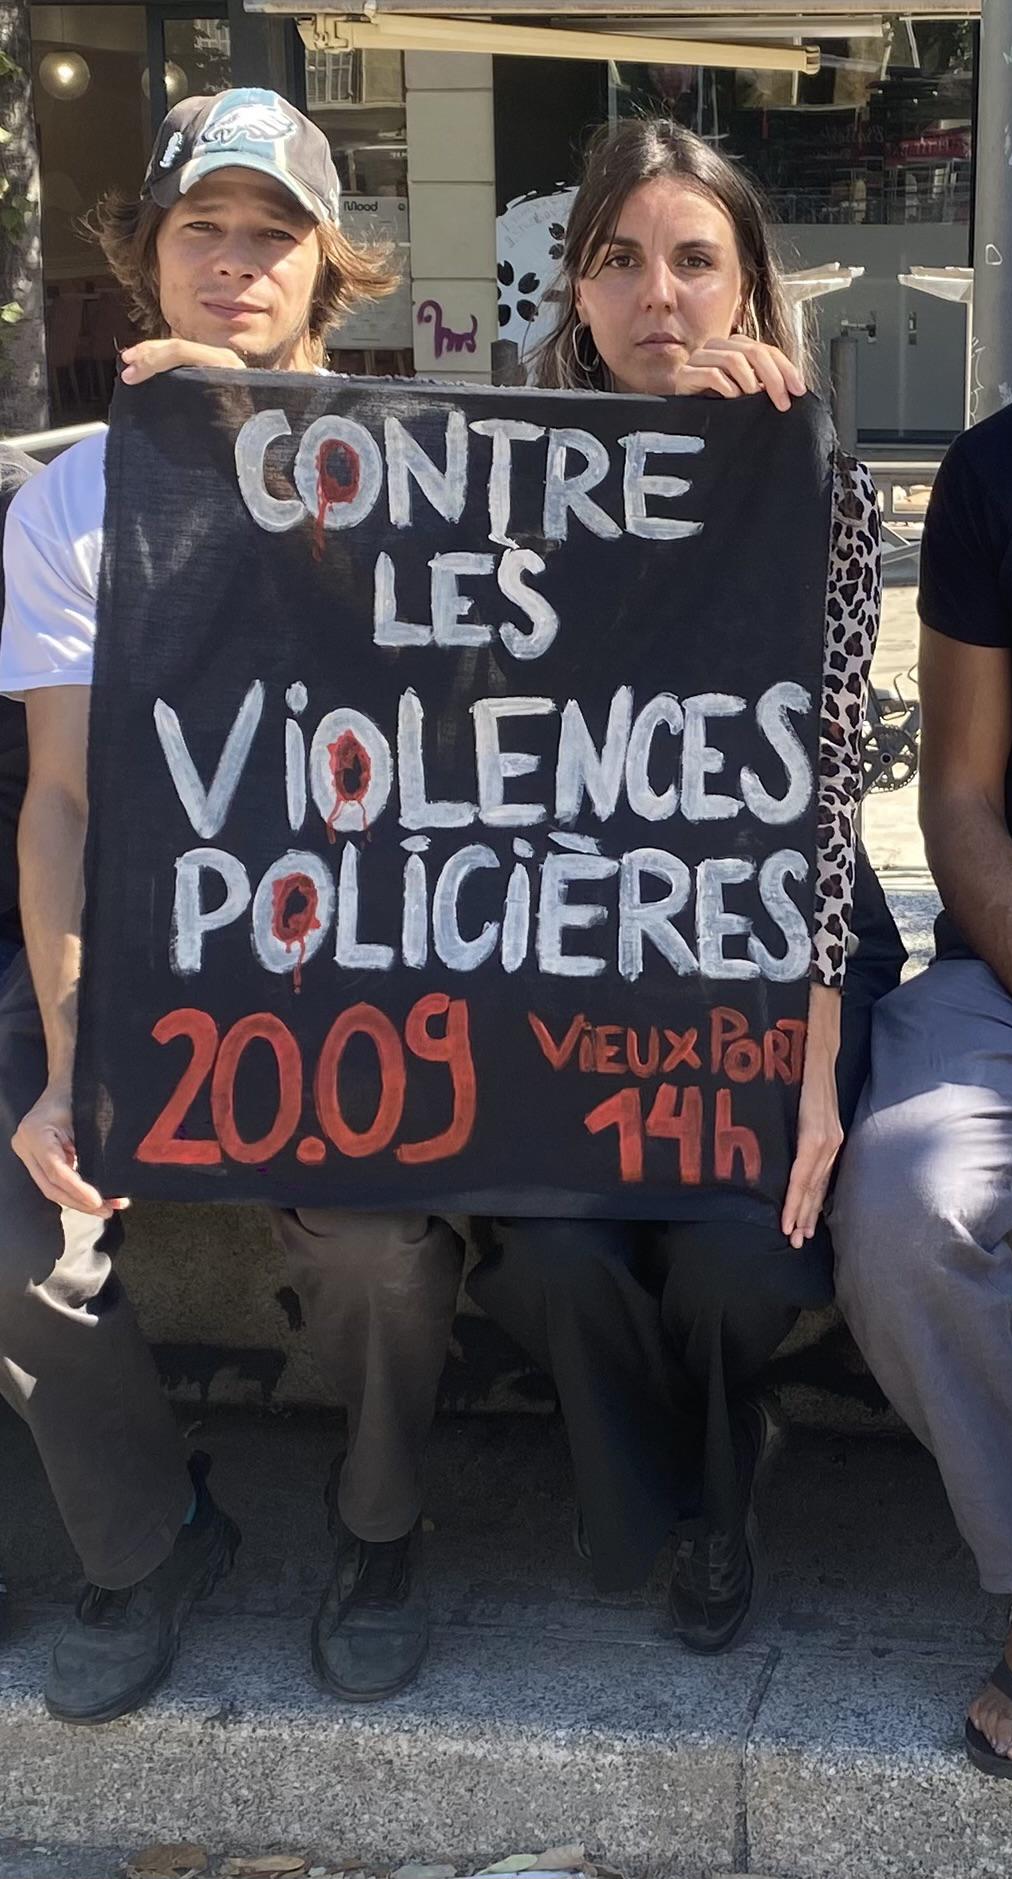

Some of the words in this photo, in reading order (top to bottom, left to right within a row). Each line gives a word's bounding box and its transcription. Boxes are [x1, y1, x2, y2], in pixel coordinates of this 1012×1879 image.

[344, 201, 378, 211] Mood
[235, 409, 705, 548] CONTRE
[373, 548, 560, 660] LES
[133, 992, 477, 1166] 20.09
[583, 1082, 762, 1185] 14h
